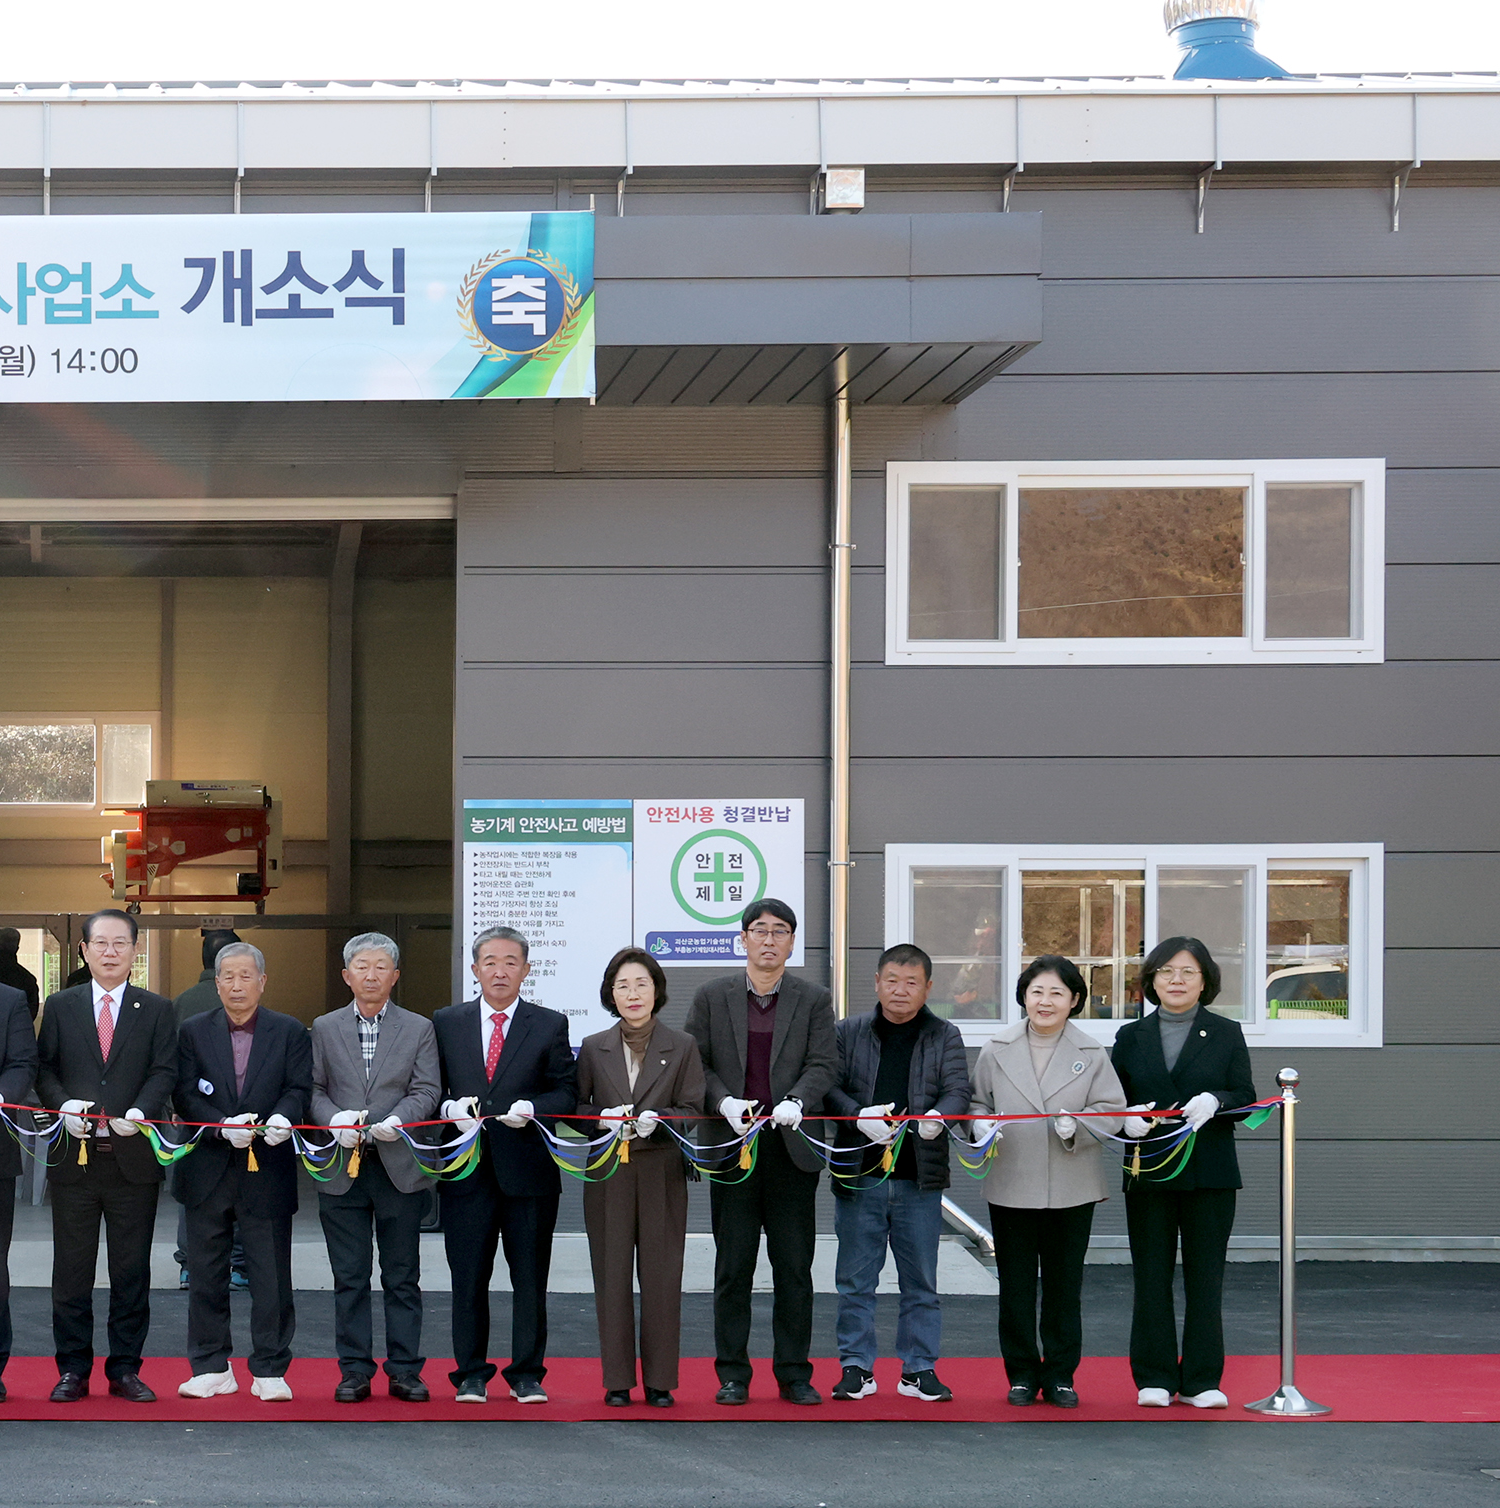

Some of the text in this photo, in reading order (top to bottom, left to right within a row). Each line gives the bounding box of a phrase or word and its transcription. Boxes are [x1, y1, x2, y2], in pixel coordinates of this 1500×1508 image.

[182, 248, 405, 326] 개소식
[489, 271, 551, 342] 축
[51, 348, 138, 373] 14:00
[647, 806, 791, 823] 안전사용 청결반납
[470, 817, 625, 833] 농기계 안전사고 예방법
[696, 853, 742, 868] 안 전
[696, 886, 742, 901] 제 일
[530, 900, 543, 908] 항상
